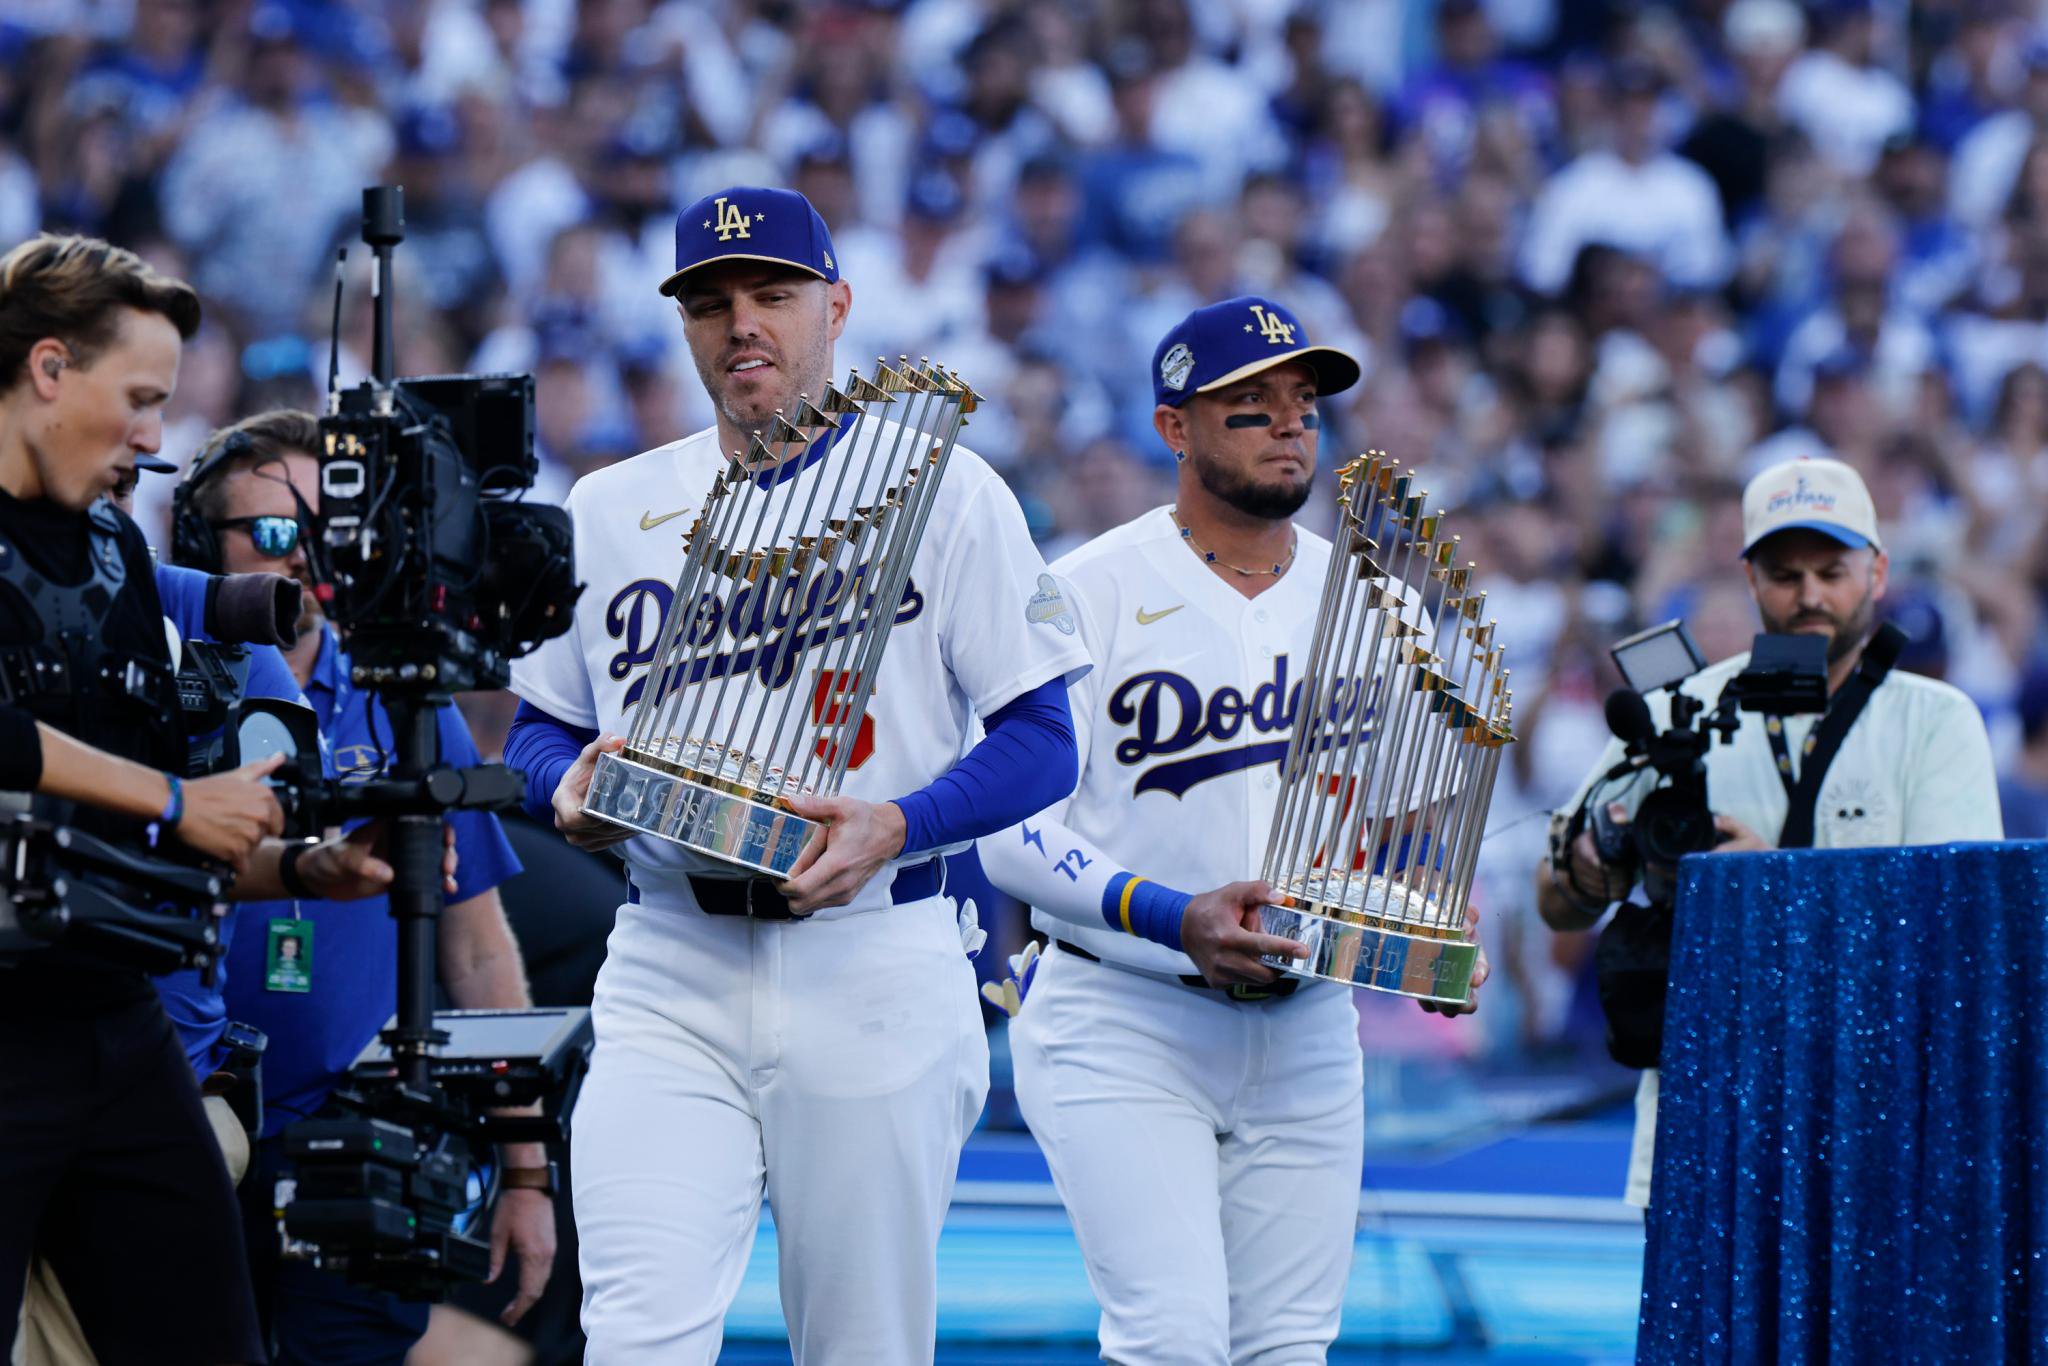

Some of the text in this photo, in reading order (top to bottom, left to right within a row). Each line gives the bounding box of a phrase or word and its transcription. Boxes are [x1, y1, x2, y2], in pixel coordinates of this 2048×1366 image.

[714, 197, 751, 242] LA
[1249, 304, 1296, 345] LA
[605, 555, 925, 700] Dodgers
[811, 668, 876, 772] 5
[1107, 652, 1386, 785] Dodger
[655, 792, 701, 825] LOS
[1053, 848, 1093, 883] 72
